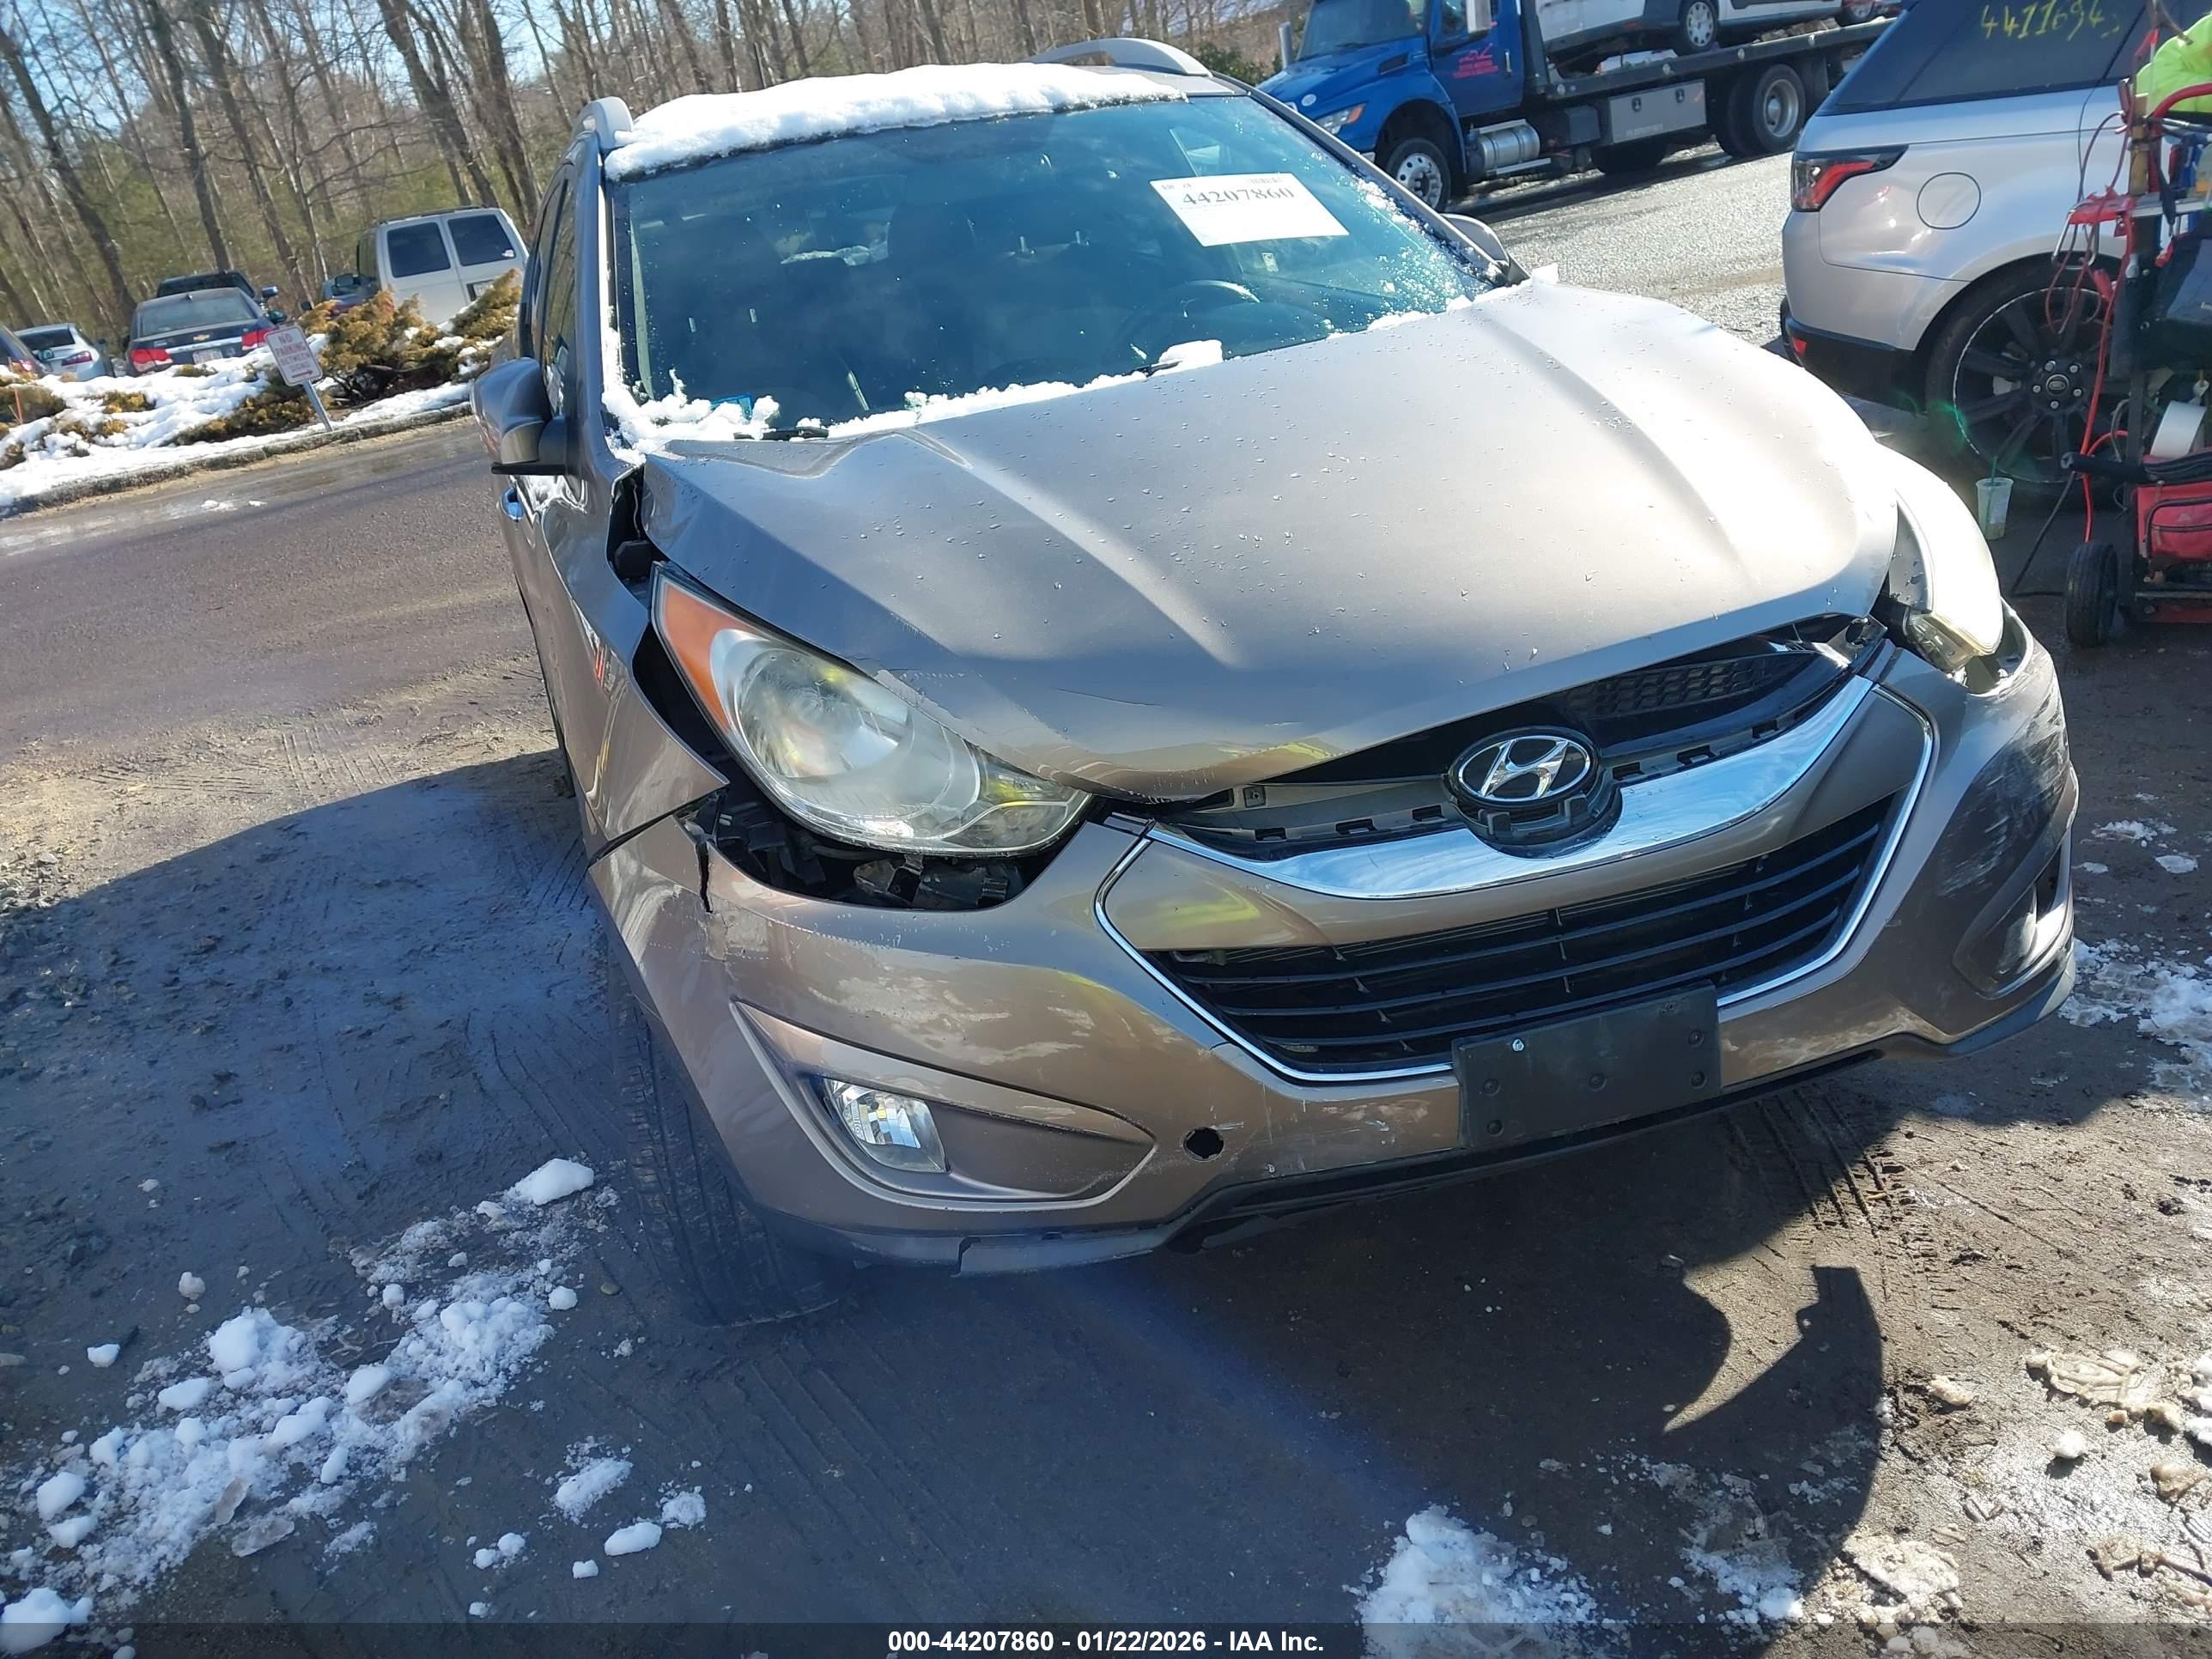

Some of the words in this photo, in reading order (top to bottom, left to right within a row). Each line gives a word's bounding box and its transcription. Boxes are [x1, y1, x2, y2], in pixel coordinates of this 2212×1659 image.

[1182, 187, 1295, 206] 44207860
[277, 332, 293, 343] NO
[275, 343, 307, 357] PARKING
